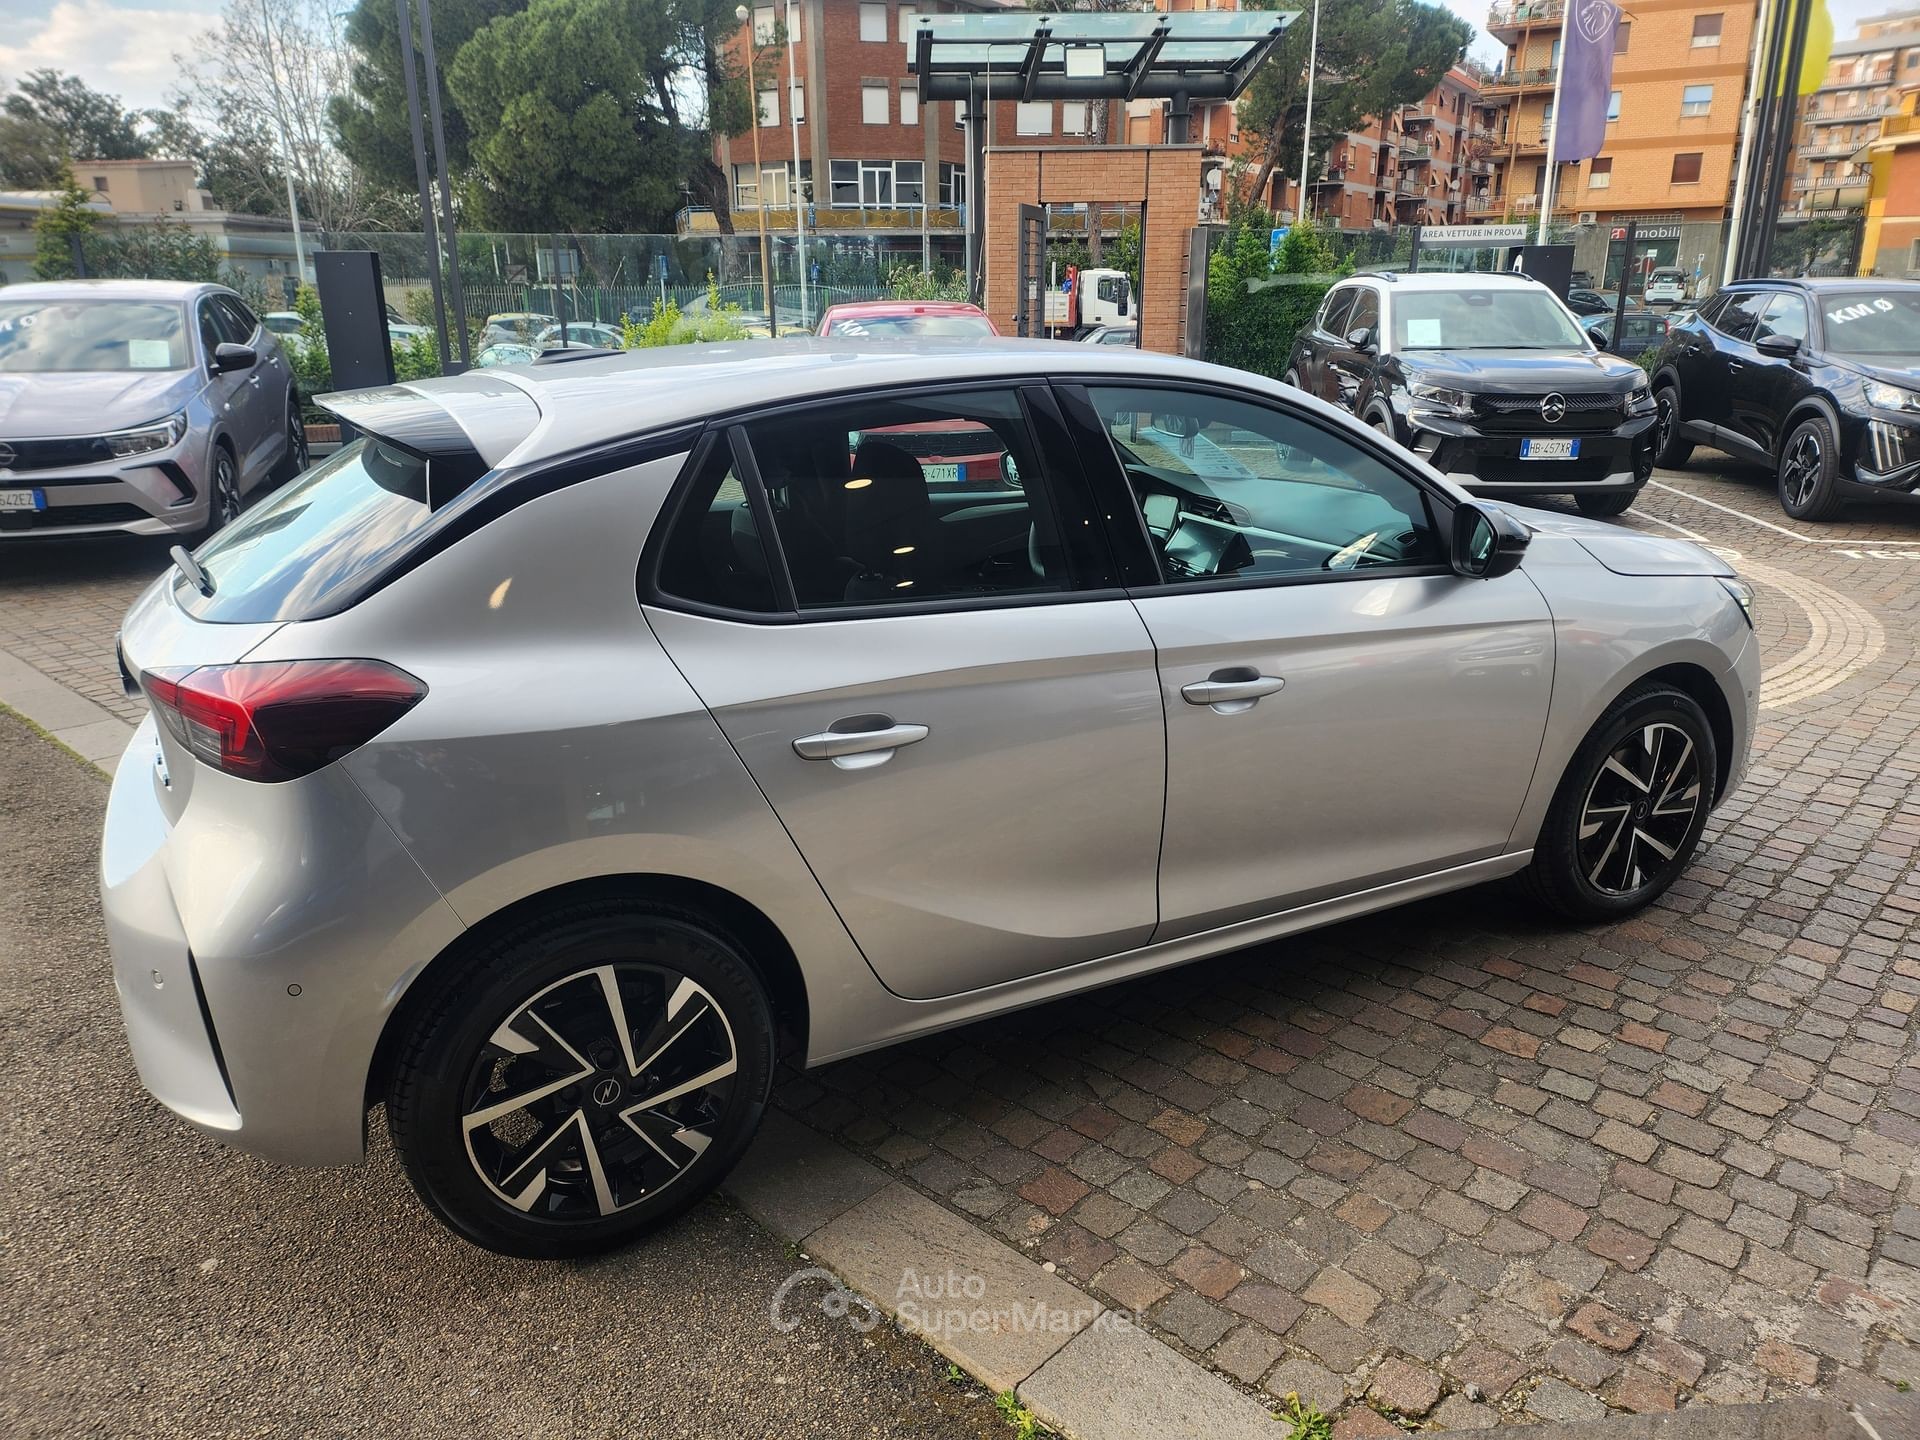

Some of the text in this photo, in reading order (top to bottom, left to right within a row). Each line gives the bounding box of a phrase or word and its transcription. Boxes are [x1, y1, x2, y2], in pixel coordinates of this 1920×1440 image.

[1422, 230, 1444, 239] AREA
[1446, 229, 1482, 238] VETTURE
[1494, 228, 1523, 237] PROVA
[1826, 303, 1876, 324] KM
